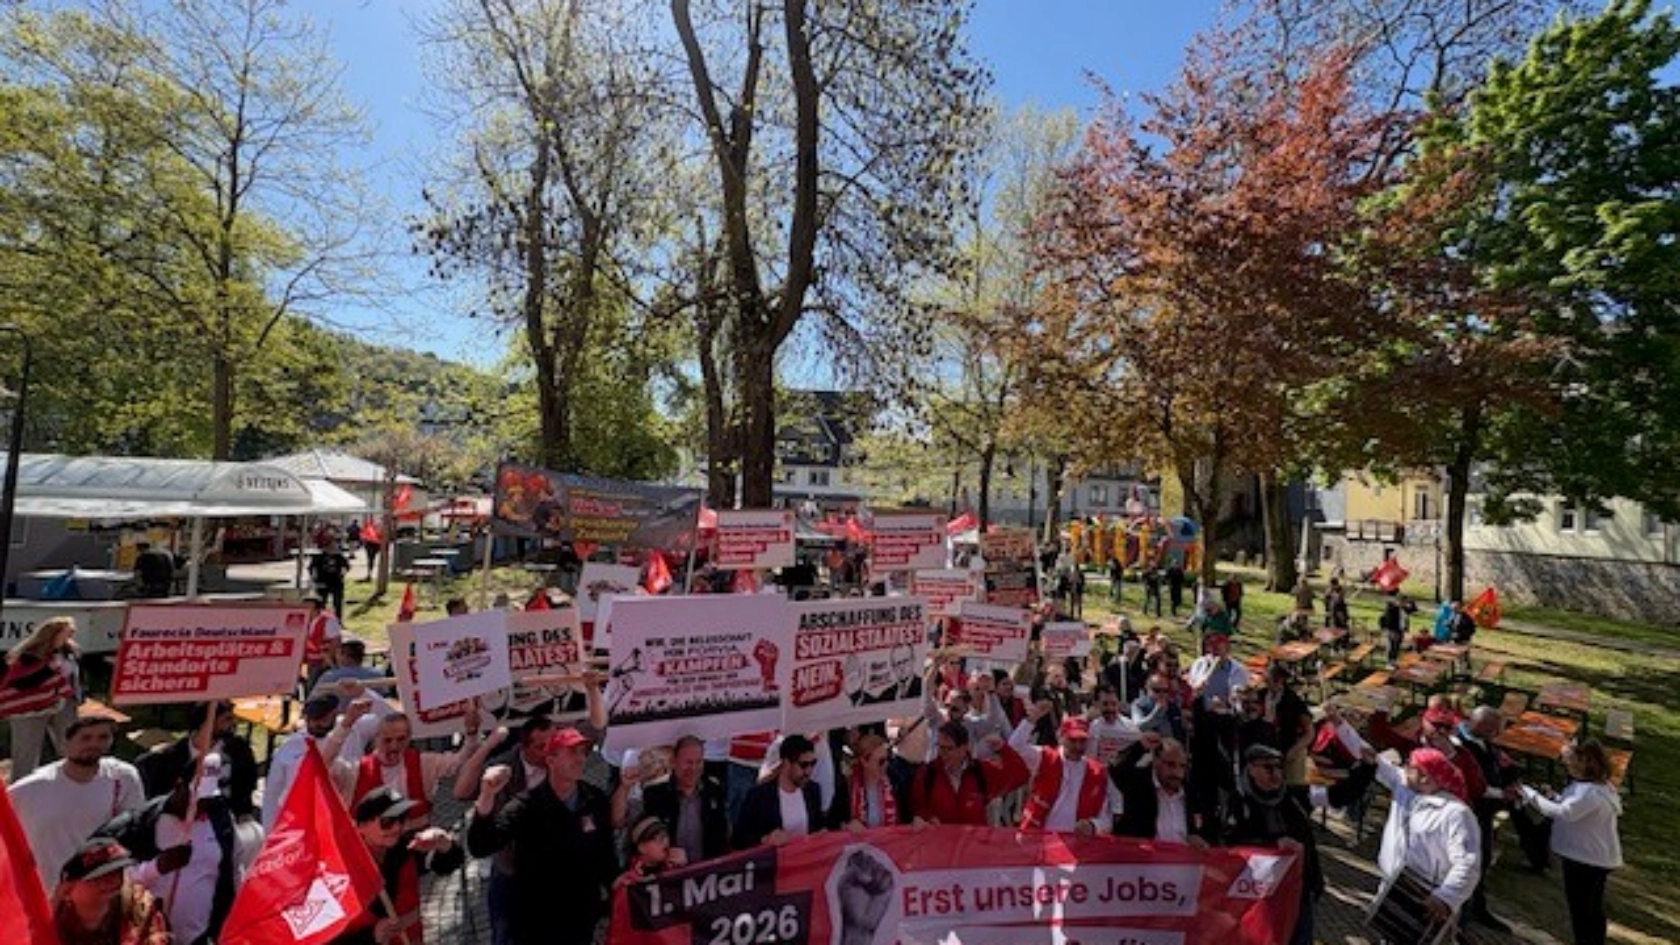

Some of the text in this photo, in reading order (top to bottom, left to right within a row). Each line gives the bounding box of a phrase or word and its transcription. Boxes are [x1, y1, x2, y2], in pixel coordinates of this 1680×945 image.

[900, 604, 922, 620] DES
[126, 641, 286, 660] Arbeitsplätze &
[122, 660, 231, 676] Standorte
[119, 676, 201, 692] sichern
[645, 861, 755, 917] 1. Mai
[903, 876, 1186, 917] Erst unsere Jobs,
[708, 904, 799, 945] 2026
